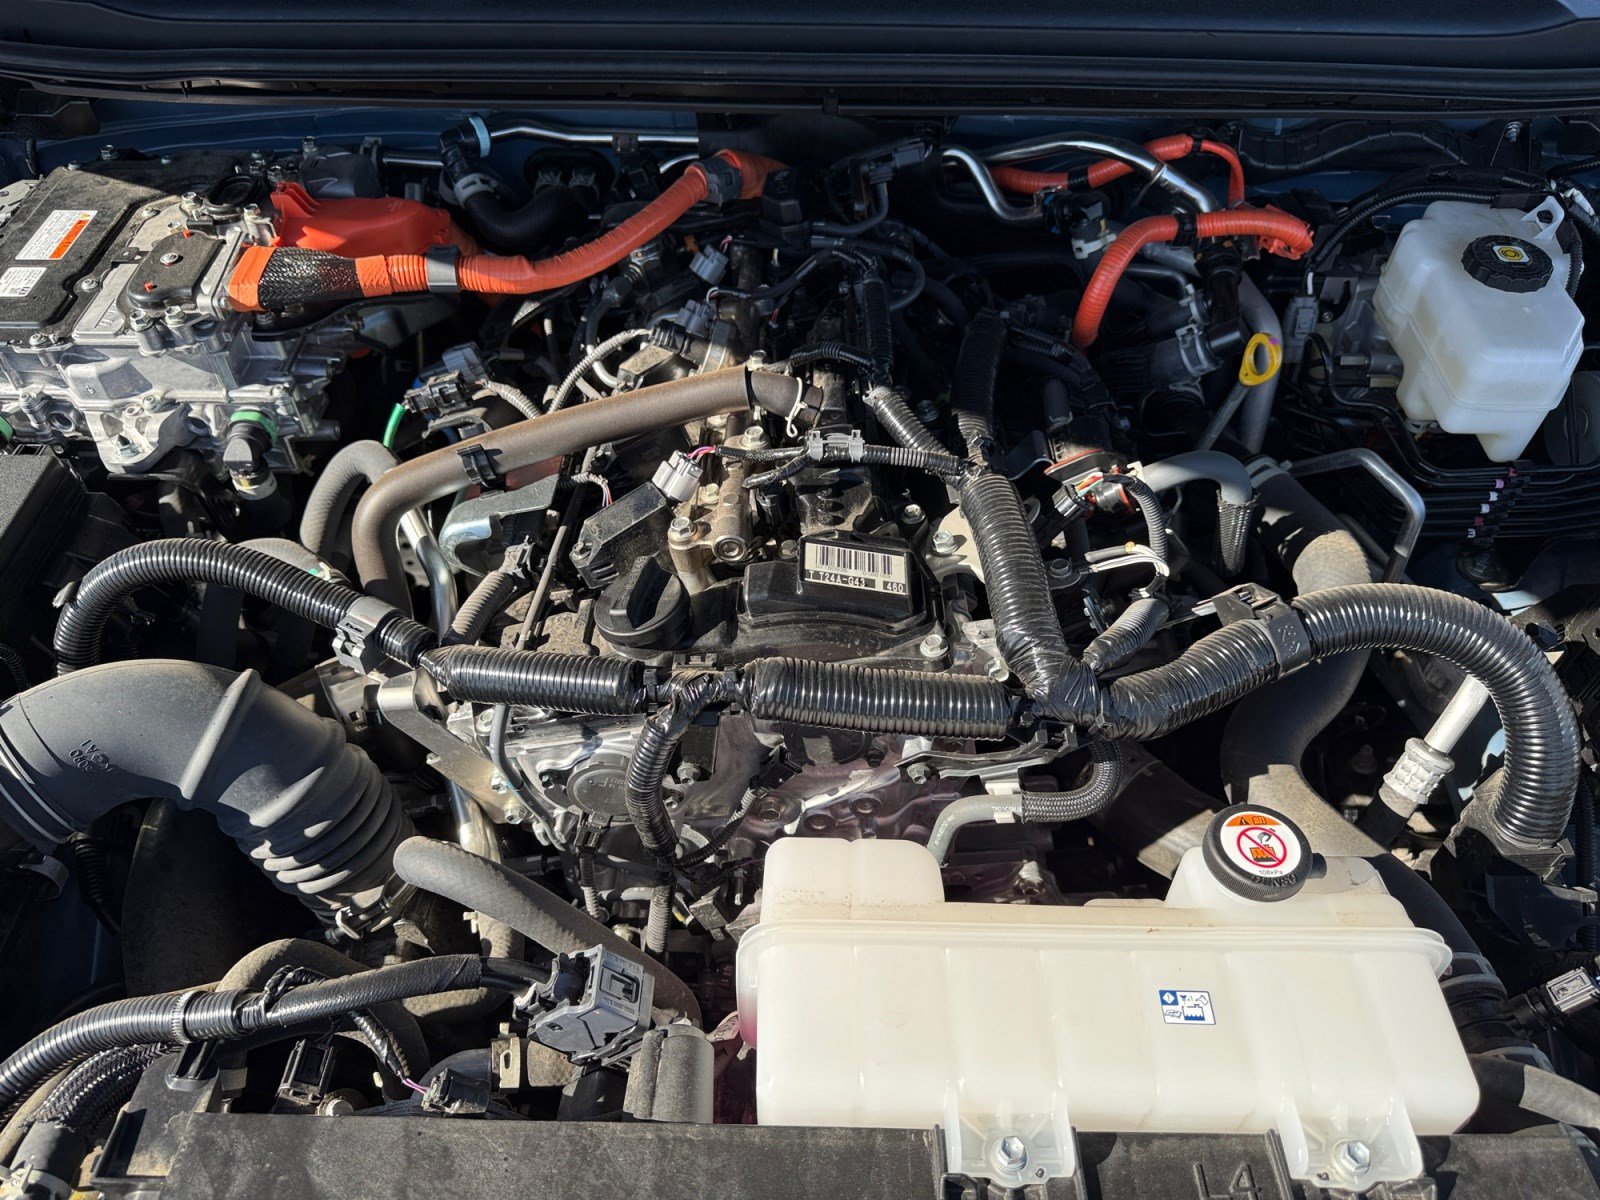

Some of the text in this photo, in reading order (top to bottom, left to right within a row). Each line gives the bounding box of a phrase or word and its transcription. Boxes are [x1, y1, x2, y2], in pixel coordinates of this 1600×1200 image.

[819, 571, 866, 588] T24A-G43
[886, 582, 904, 593] 460
[1252, 874, 1297, 887] DENSO
[1192, 1162, 1262, 1200] L4
